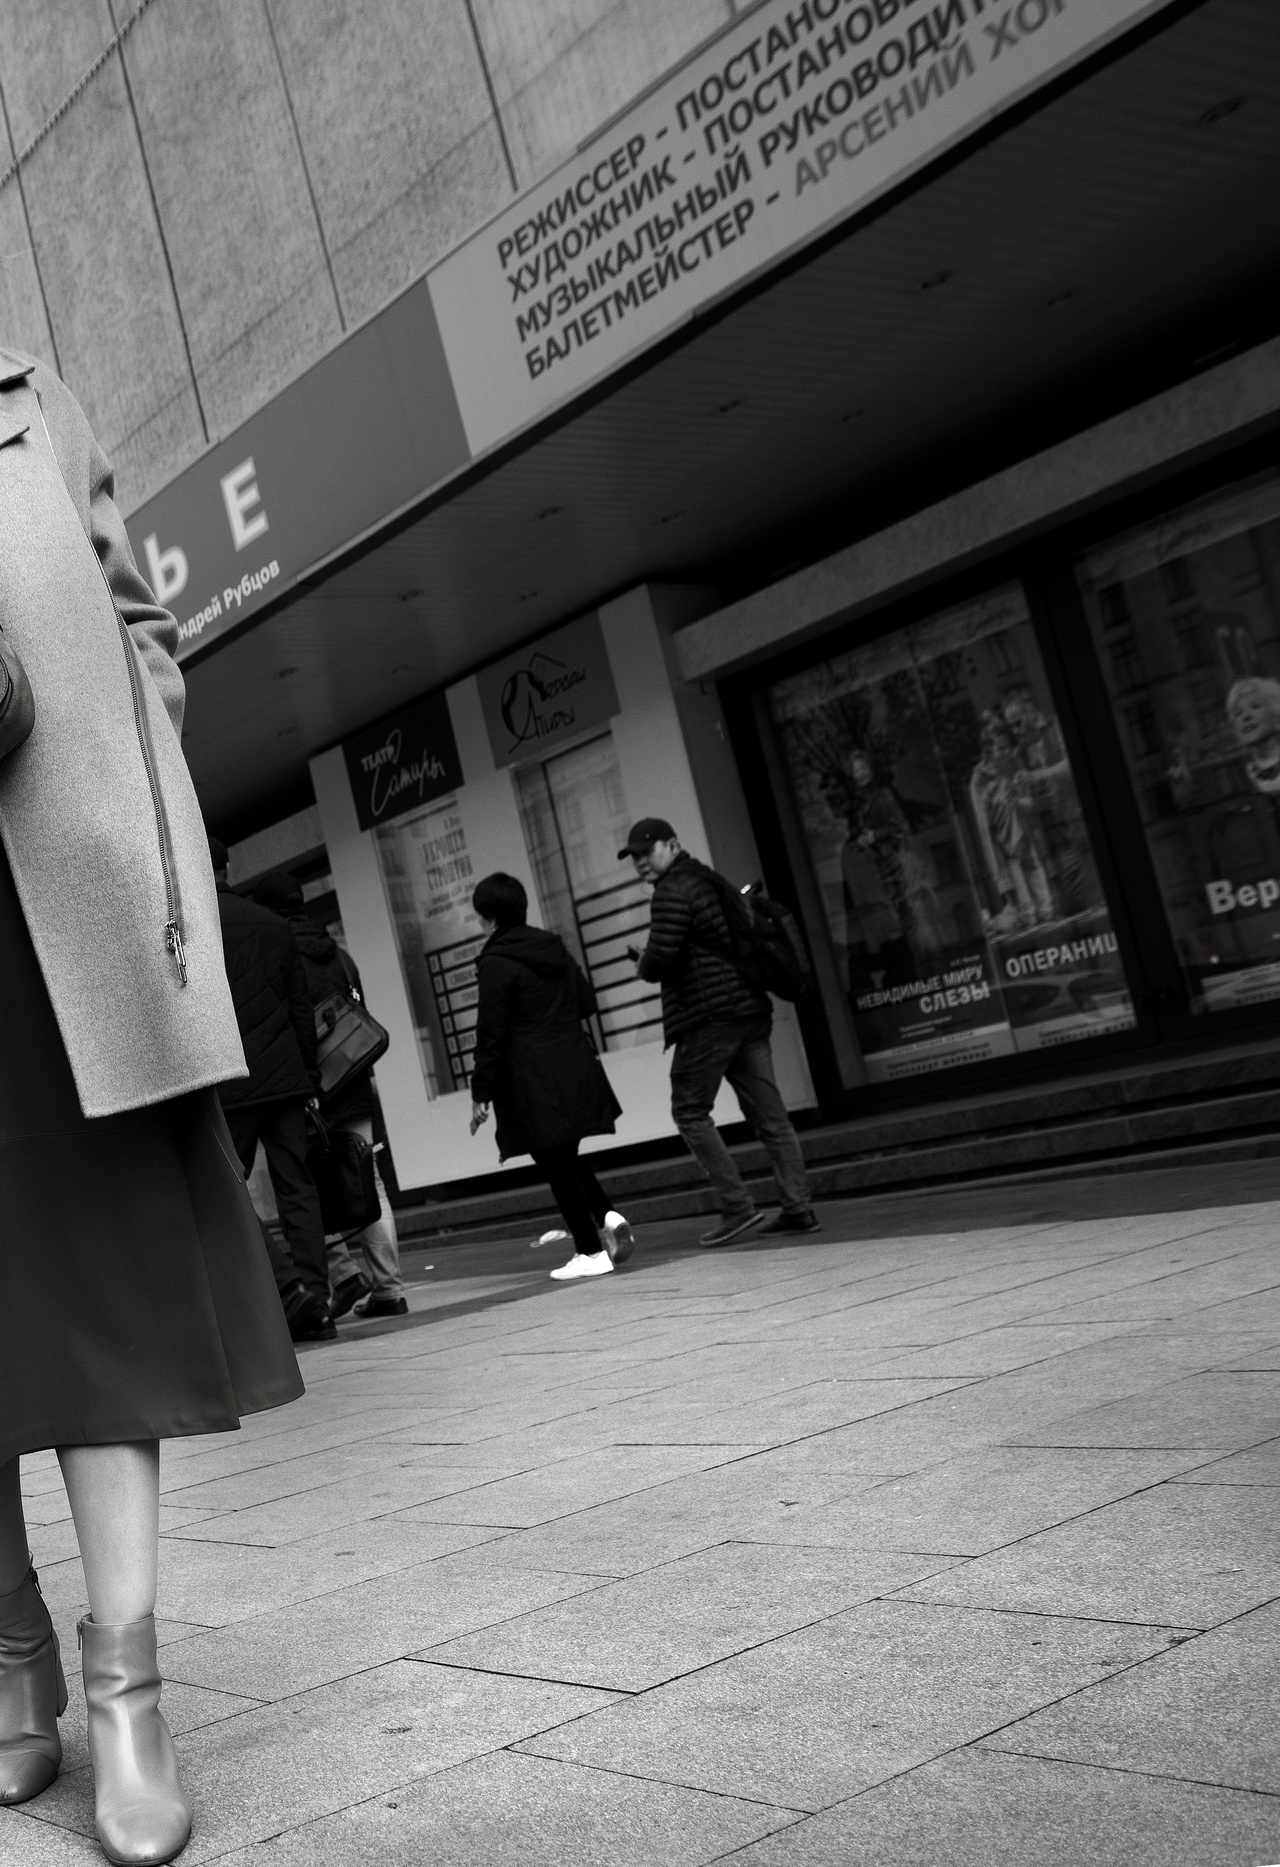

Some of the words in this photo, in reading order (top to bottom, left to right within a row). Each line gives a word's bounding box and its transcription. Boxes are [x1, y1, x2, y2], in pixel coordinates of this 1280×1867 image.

[497, 133, 646, 269] РЕЖИССЕР
[675, 0, 851, 131] ПОСТАНО
[507, 154, 676, 302] ХУДОЖНИК
[703, 0, 917, 155] ПОСТАНОВ
[526, 198, 755, 380] БАЛЕТМЕЙСТЕР
[793, 32, 976, 197] АРСЕНИЙ
[516, 143, 752, 342] МУЗЫКАЛЬНЫЙ
[178, 594, 222, 643] ндрей
[222, 559, 281, 609] Рубцов
[856, 975, 943, 1011] НЕВИДИМЫЕ
[943, 963, 983, 987] МИРУ
[920, 979, 991, 1014] СЛЕЗЫ
